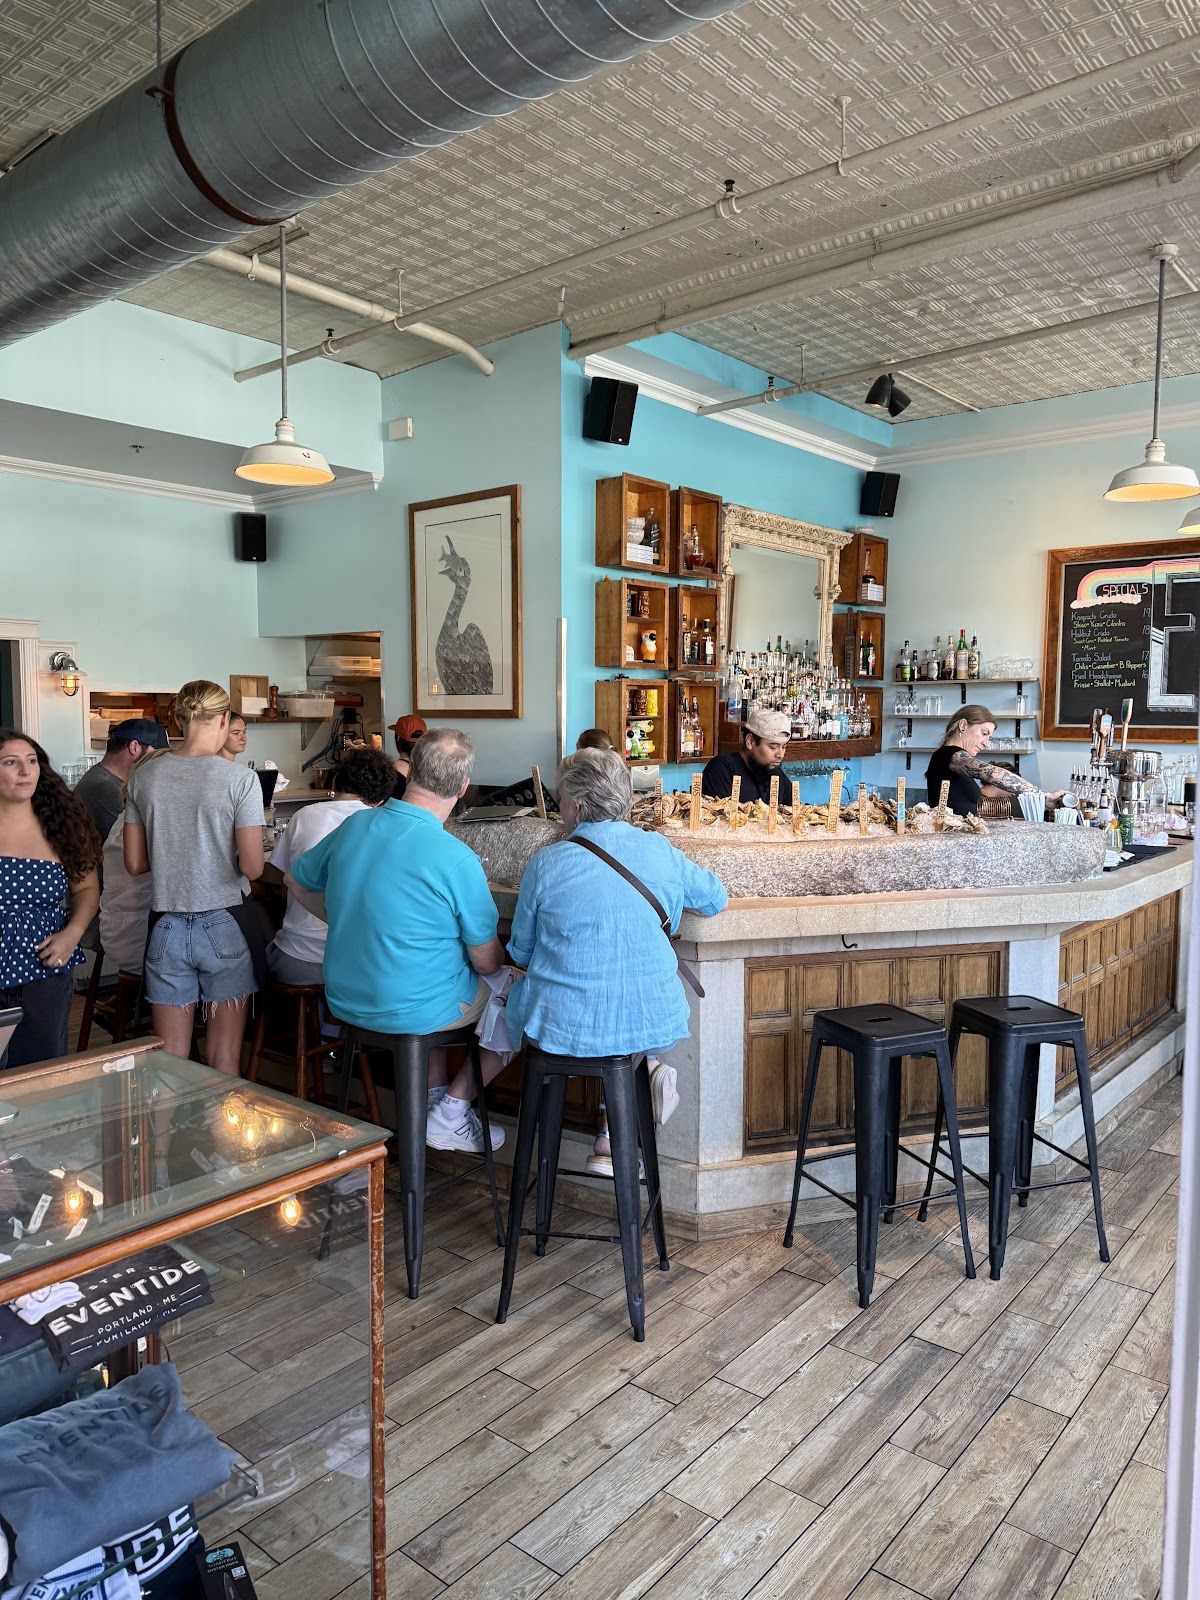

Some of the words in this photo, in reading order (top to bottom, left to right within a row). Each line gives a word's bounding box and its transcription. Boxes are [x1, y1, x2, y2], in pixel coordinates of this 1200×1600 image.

[1102, 583, 1149, 597] SPECIALS
[1100, 610, 1117, 619] Crudo
[1073, 621, 1087, 629] Shiso
[1106, 619, 1126, 627] Cilantro
[1071, 628, 1091, 638] Halibut
[1093, 627, 1110, 637] Crudo
[1071, 652, 1092, 662] Tomato
[1094, 651, 1111, 661] Salad
[1092, 661, 1116, 669] Cucumber
[1125, 660, 1147, 670] Peppers
[1071, 669, 1087, 680] Fried
[1088, 669, 1122, 680] Headcheese
[1093, 679, 1111, 687] Shallot
[1114, 678, 1136, 688] Mustard
[48, 1260, 201, 1337] EVENTIDE
[97, 1304, 153, 1335] PORTLAND
[162, 1293, 178, 1306] ME
